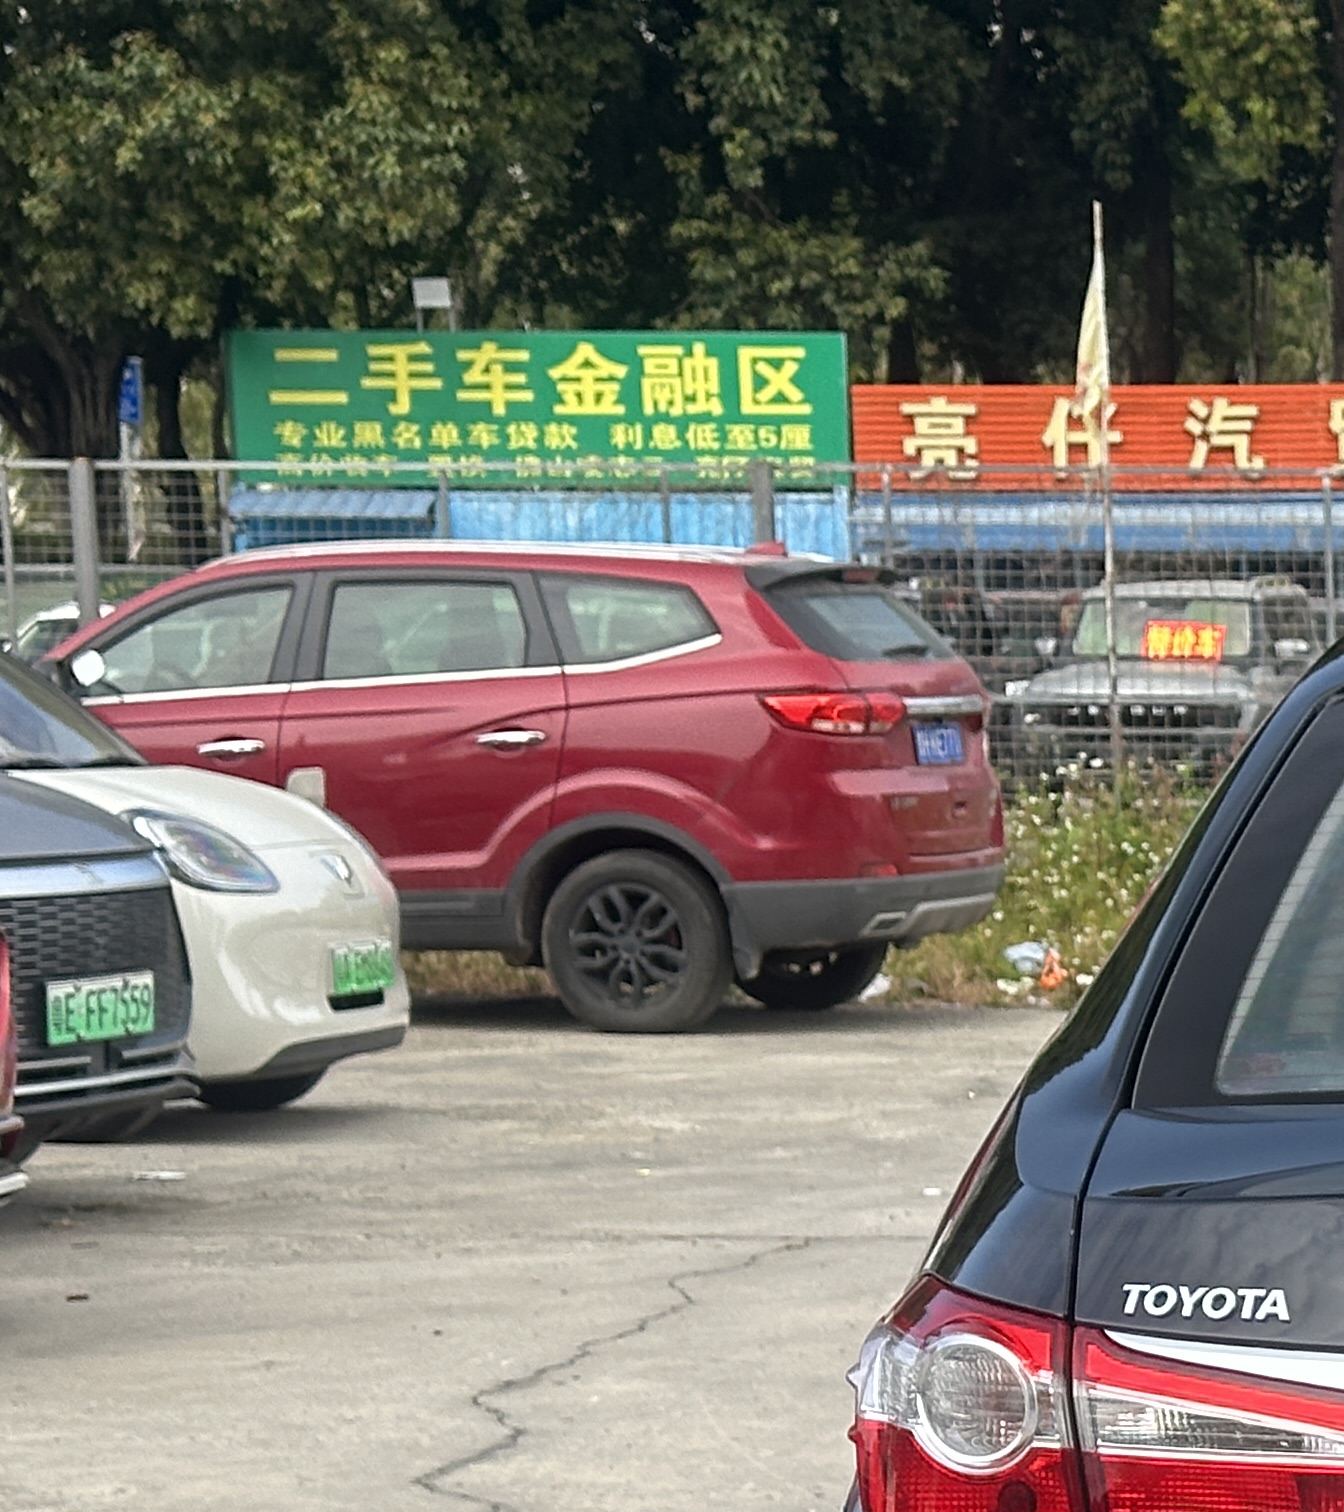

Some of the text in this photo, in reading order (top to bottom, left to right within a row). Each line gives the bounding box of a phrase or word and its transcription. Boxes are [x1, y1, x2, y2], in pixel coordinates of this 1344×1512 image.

[268, 338, 814, 418] 二手车金融区
[273, 420, 815, 451] 专业黑名单车贷款 利息低至5厘
[1122, 1283, 1290, 1321] TOYOTA
